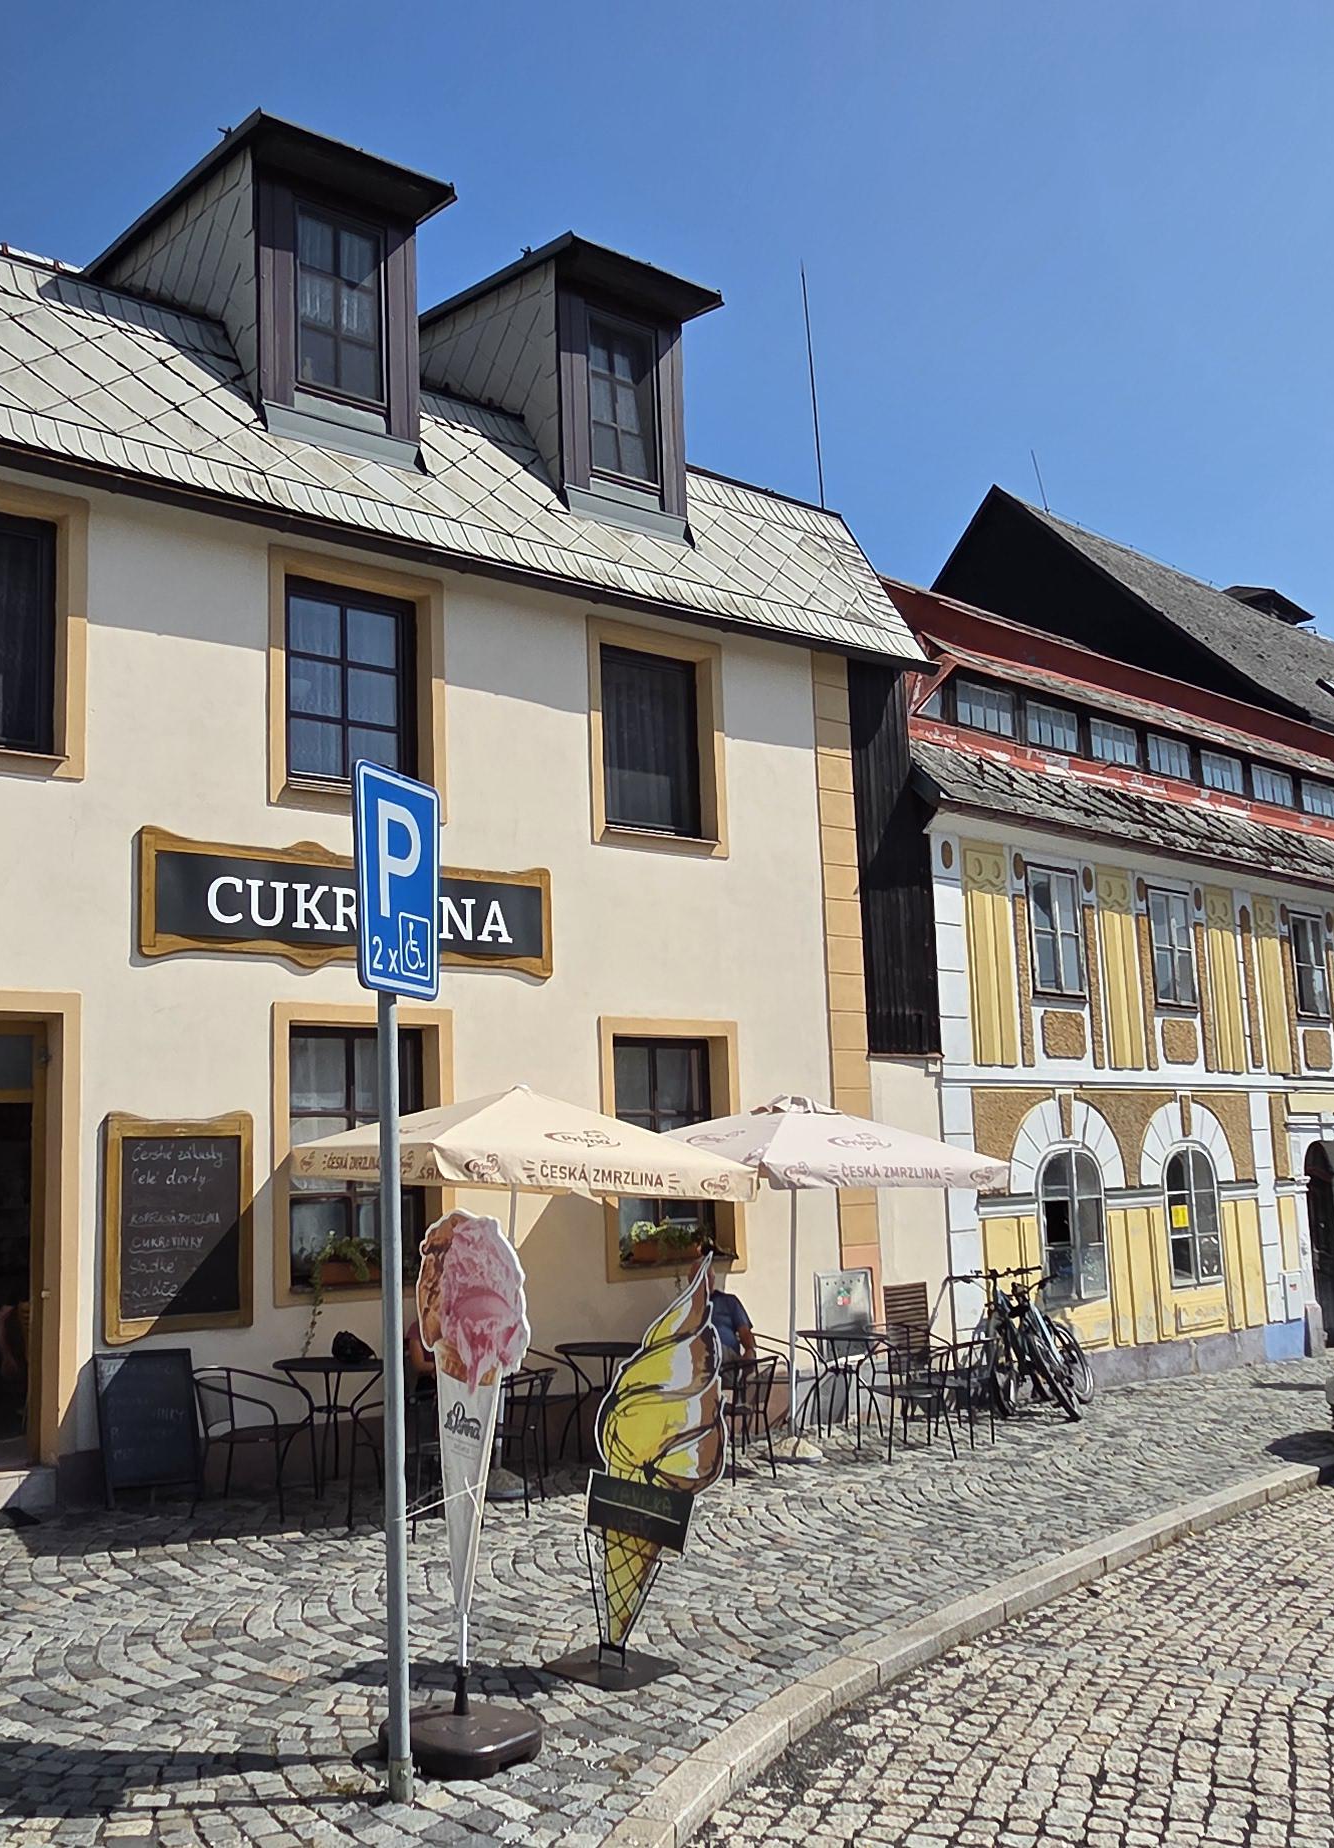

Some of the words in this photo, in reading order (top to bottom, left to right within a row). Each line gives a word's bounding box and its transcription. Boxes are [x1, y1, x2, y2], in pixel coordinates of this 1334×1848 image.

[377, 798, 422, 918] P
[207, 876, 513, 944] CUKRNA
[540, 1160, 587, 1183] ČESKÁ
[593, 1168, 664, 1188] ZMRZLINA
[841, 1163, 880, 1179] ČESKÁ
[883, 1166, 942, 1180] ZMRZLINA
